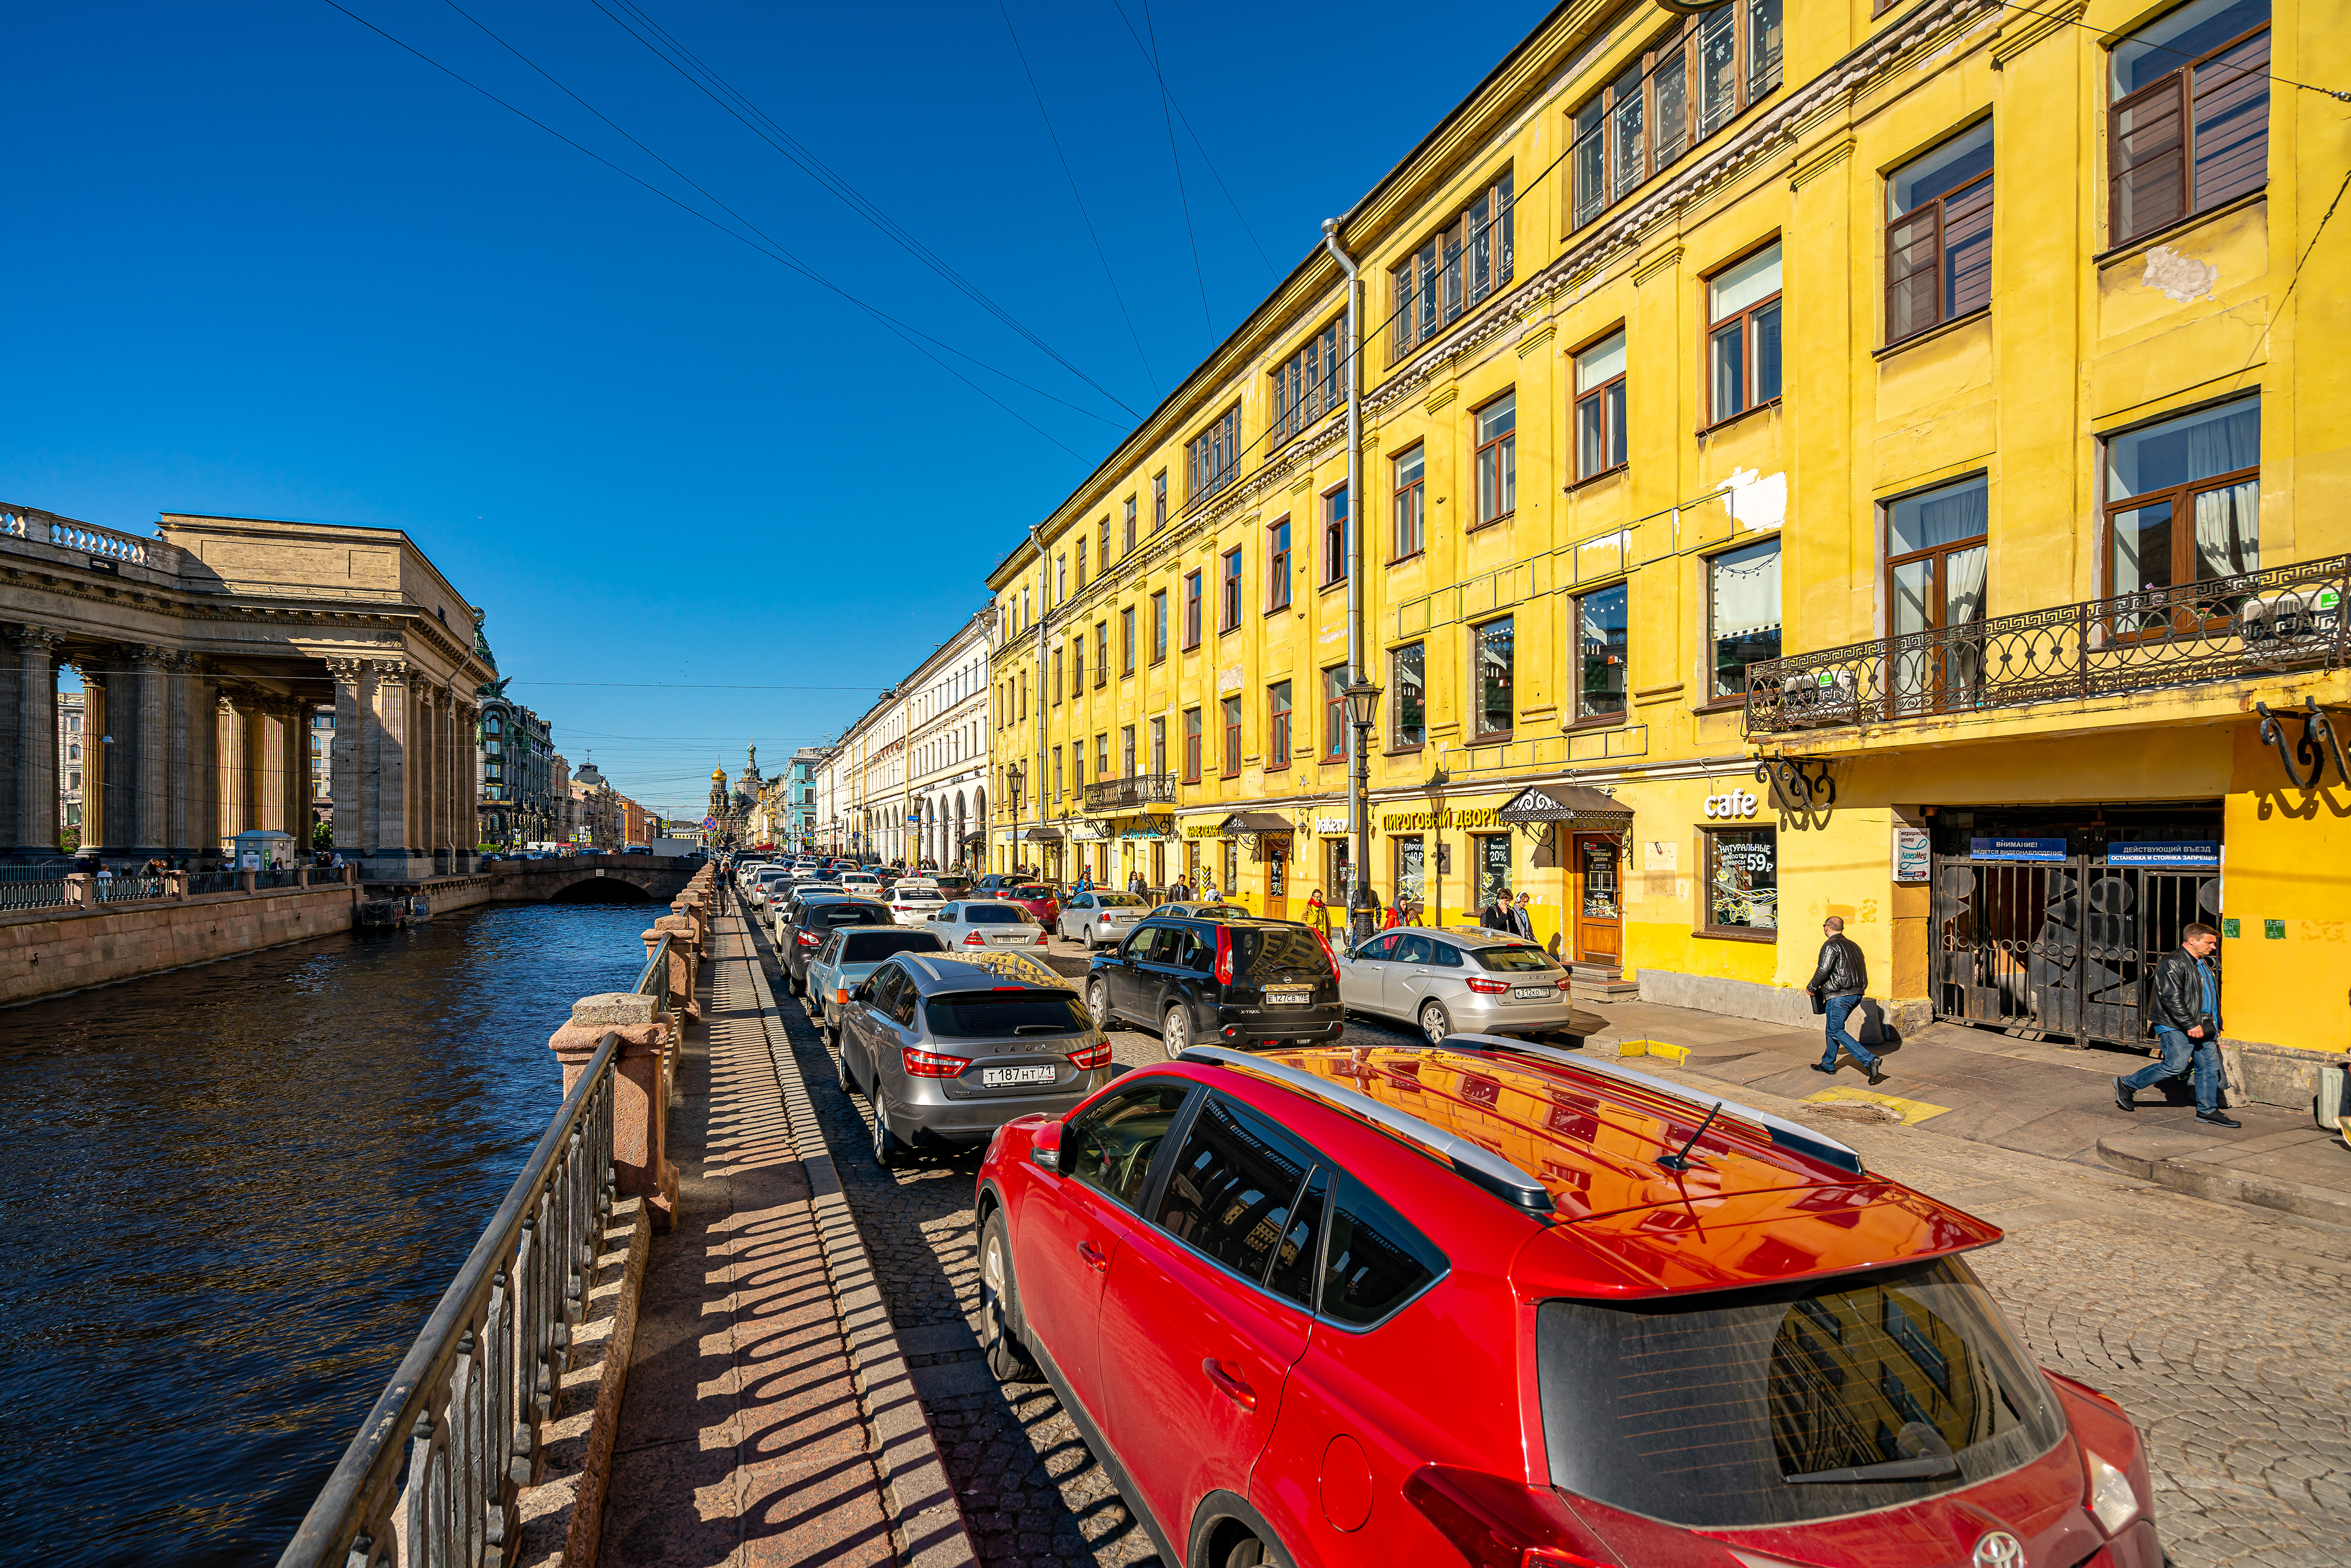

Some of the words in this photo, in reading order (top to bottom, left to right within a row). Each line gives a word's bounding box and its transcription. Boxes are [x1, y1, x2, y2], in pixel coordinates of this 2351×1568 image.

[1704, 788, 1758, 816] cafe
[1382, 808, 1450, 829] ПИРОГОВЫЙ
[1454, 807, 1509, 829] ДВОРИ
[1315, 816, 1349, 832] bakery
[1404, 843, 1424, 852] ПИРОГИ
[1719, 843, 1771, 854] НАТУРАЛЬНЫЕ
[1490, 850, 1507, 862] 20%
[1901, 852, 1927, 860] ЛазерМед
[995, 1044, 1046, 1053] LADA
[1040, 1066, 1051, 1076] 71
